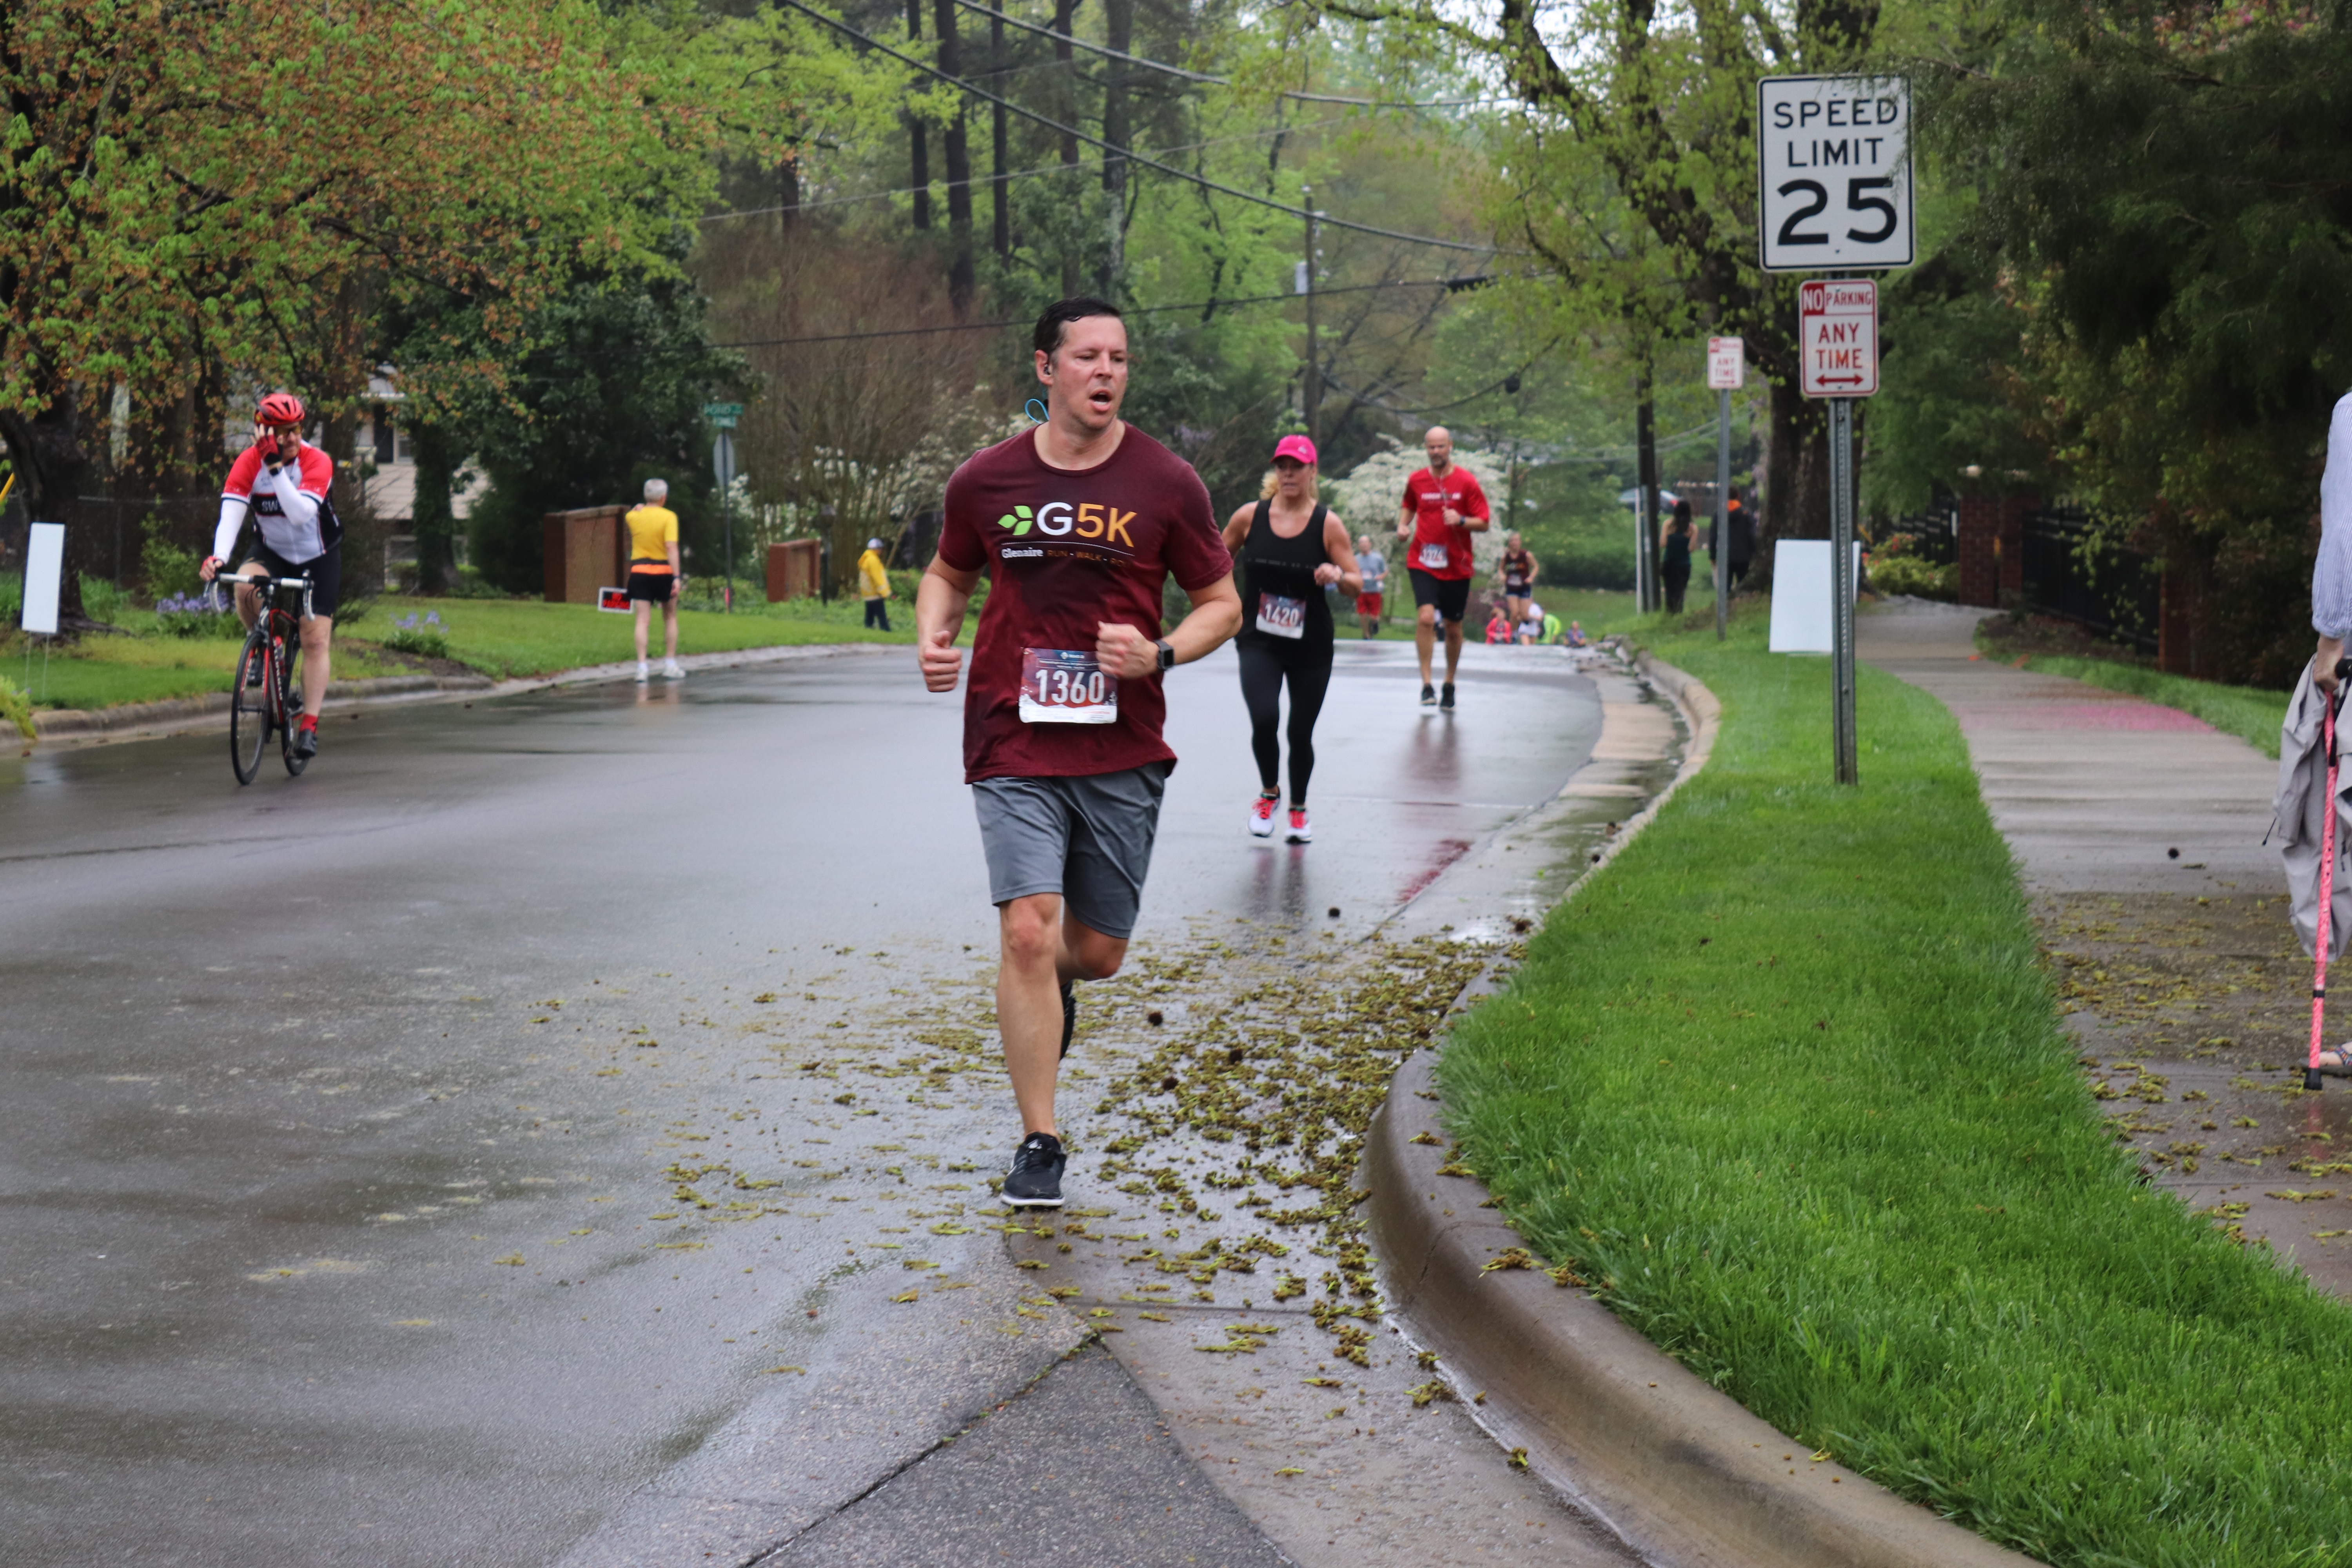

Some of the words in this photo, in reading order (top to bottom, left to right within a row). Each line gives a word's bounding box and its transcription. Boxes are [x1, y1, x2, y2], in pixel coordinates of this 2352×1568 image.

[1774, 98, 1898, 129] SPEED
[1788, 137, 1884, 167] LIMIT
[1777, 177, 1897, 245] 25
[1803, 289, 1824, 311] NO
[1826, 291, 1872, 306] PARKING
[1818, 322, 1860, 344] ANY
[1816, 347, 1862, 370] TIME
[1036, 501, 1137, 548] G5K
[1001, 547, 1044, 559] Glenaire
[1076, 551, 1102, 561] WALK
[1265, 603, 1300, 627] 1420
[1035, 669, 1105, 704] 1360
